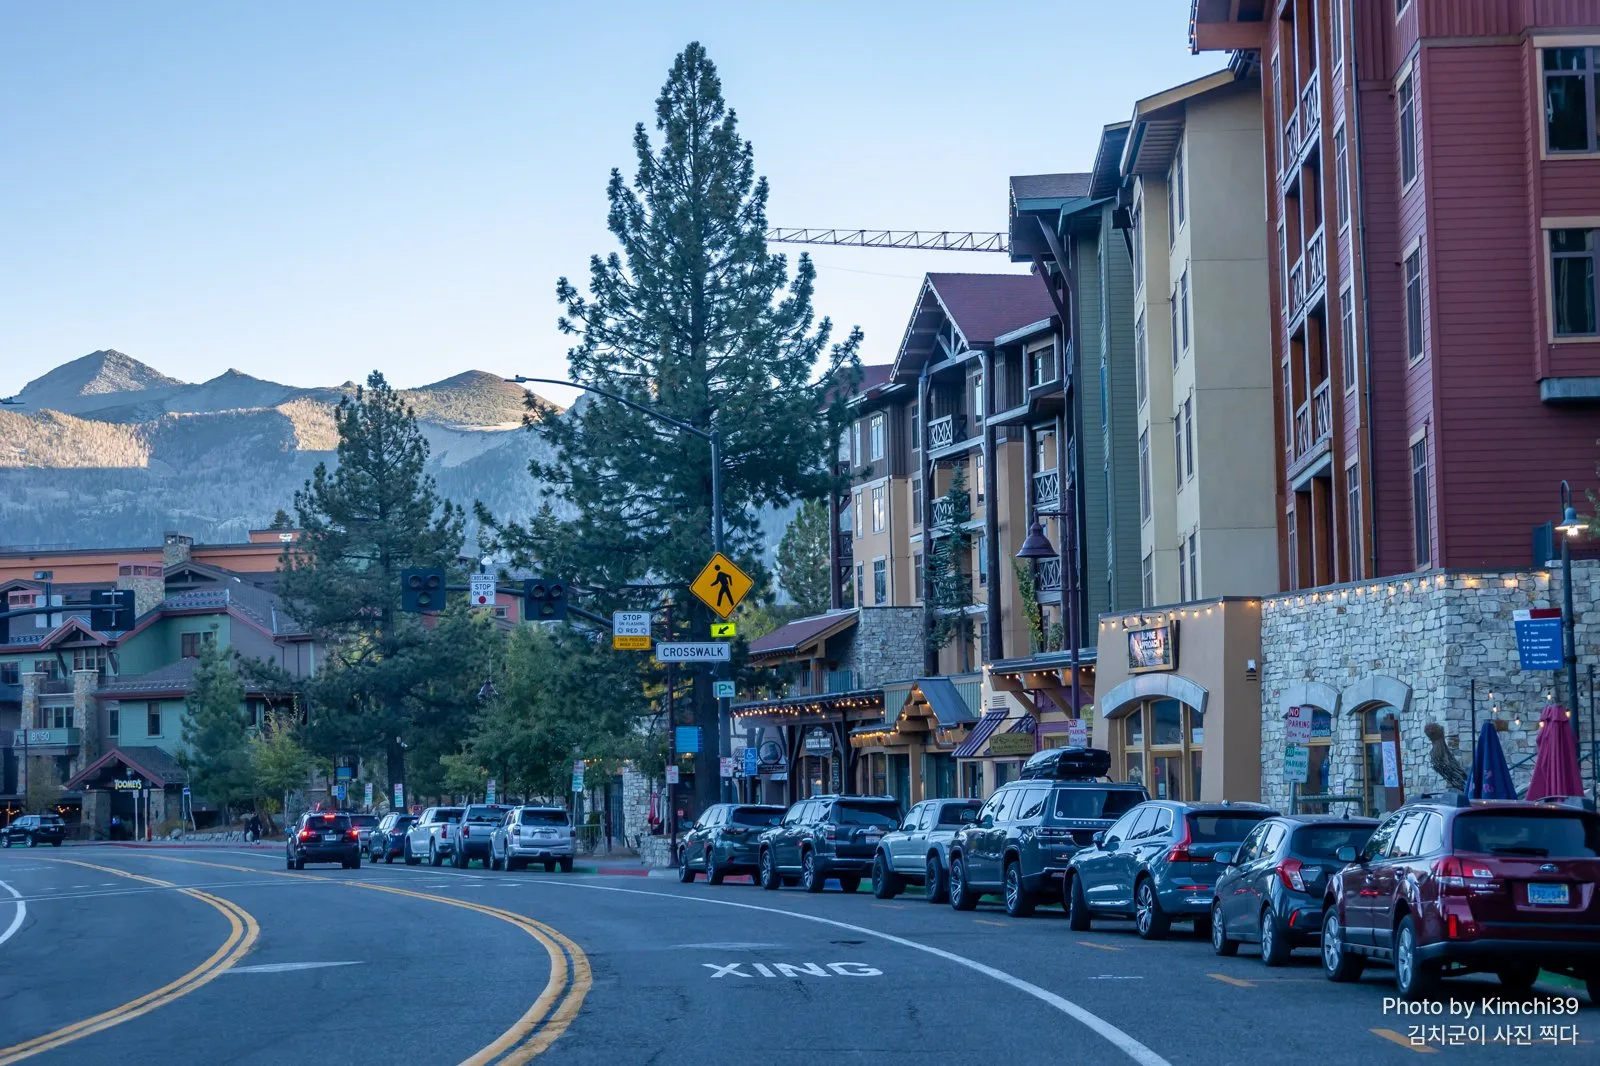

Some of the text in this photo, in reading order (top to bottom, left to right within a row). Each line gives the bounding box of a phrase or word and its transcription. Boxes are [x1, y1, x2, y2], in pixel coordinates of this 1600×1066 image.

[663, 648, 724, 656] CROSSWALK
[1288, 708, 1299, 717] NO
[1288, 720, 1310, 728] PARKING
[1286, 748, 1294, 756] 30
[1286, 760, 1306, 768] PARKING
[701, 962, 884, 978] XING
